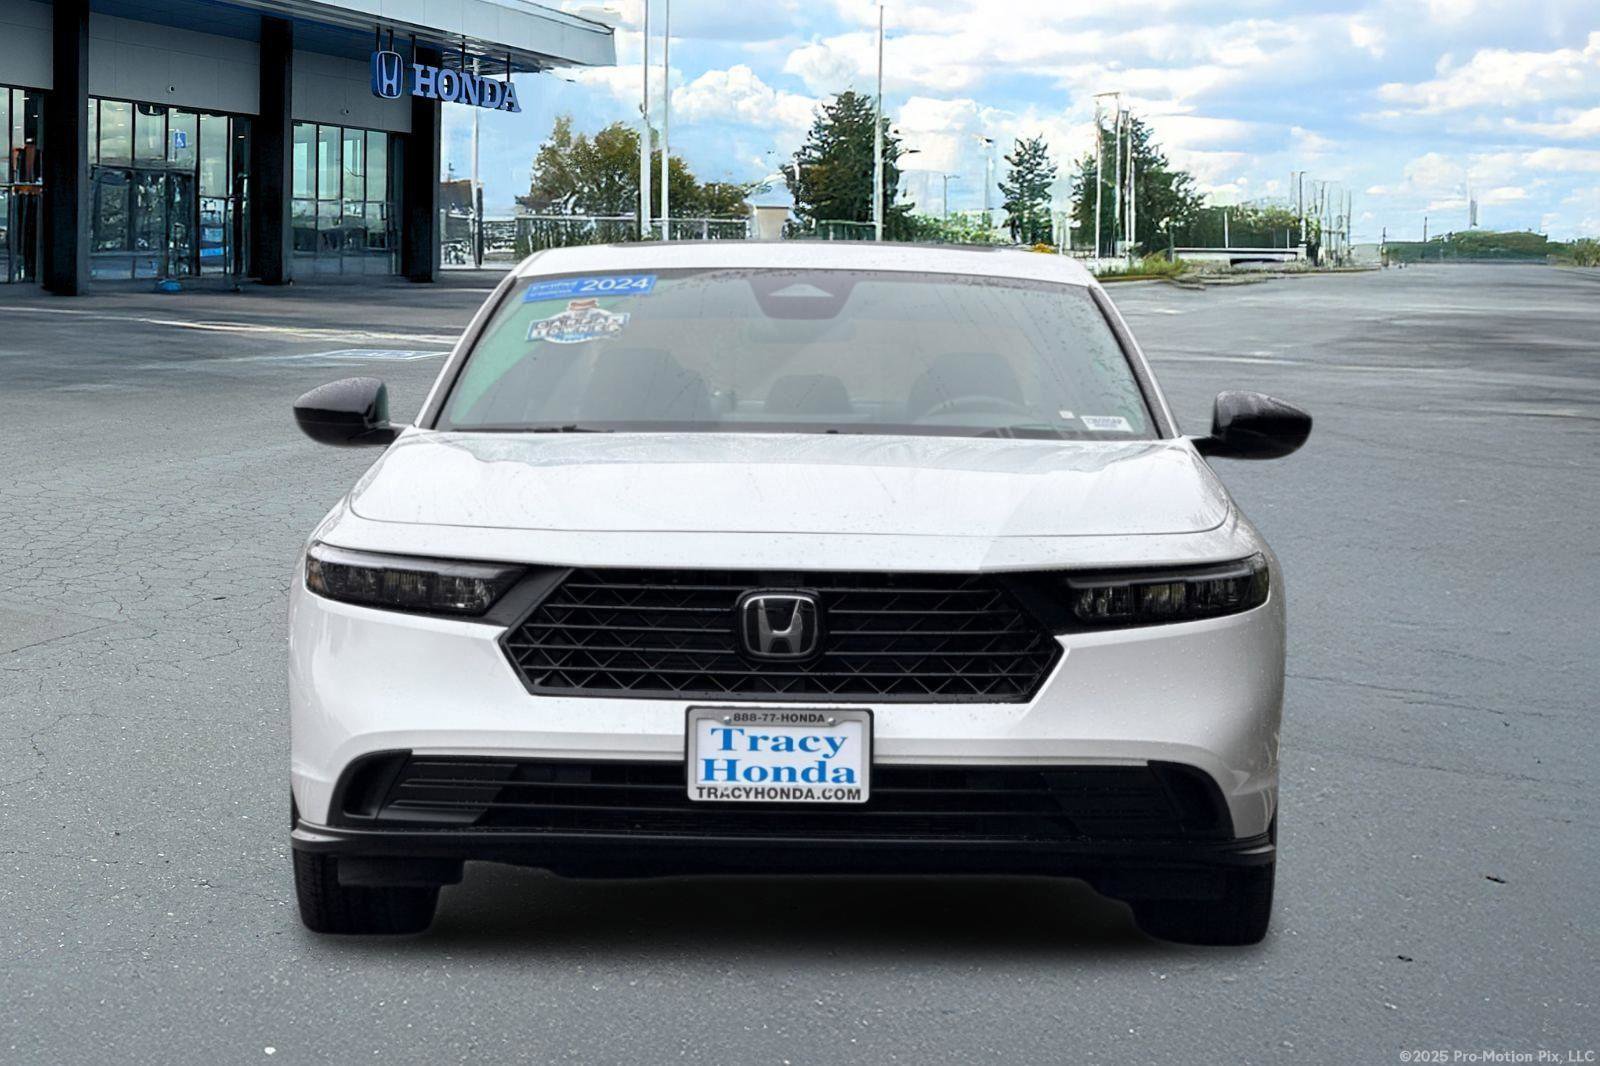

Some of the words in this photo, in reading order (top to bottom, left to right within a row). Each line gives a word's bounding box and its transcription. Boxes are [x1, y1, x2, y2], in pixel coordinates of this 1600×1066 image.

[412, 63, 522, 113] HONDA
[580, 278, 649, 292] 2024
[733, 712, 825, 723] 888-77-HONDA
[710, 728, 848, 759] Tracy
[701, 758, 857, 784] Honda
[696, 786, 862, 801] TRACYHONDA.COM
